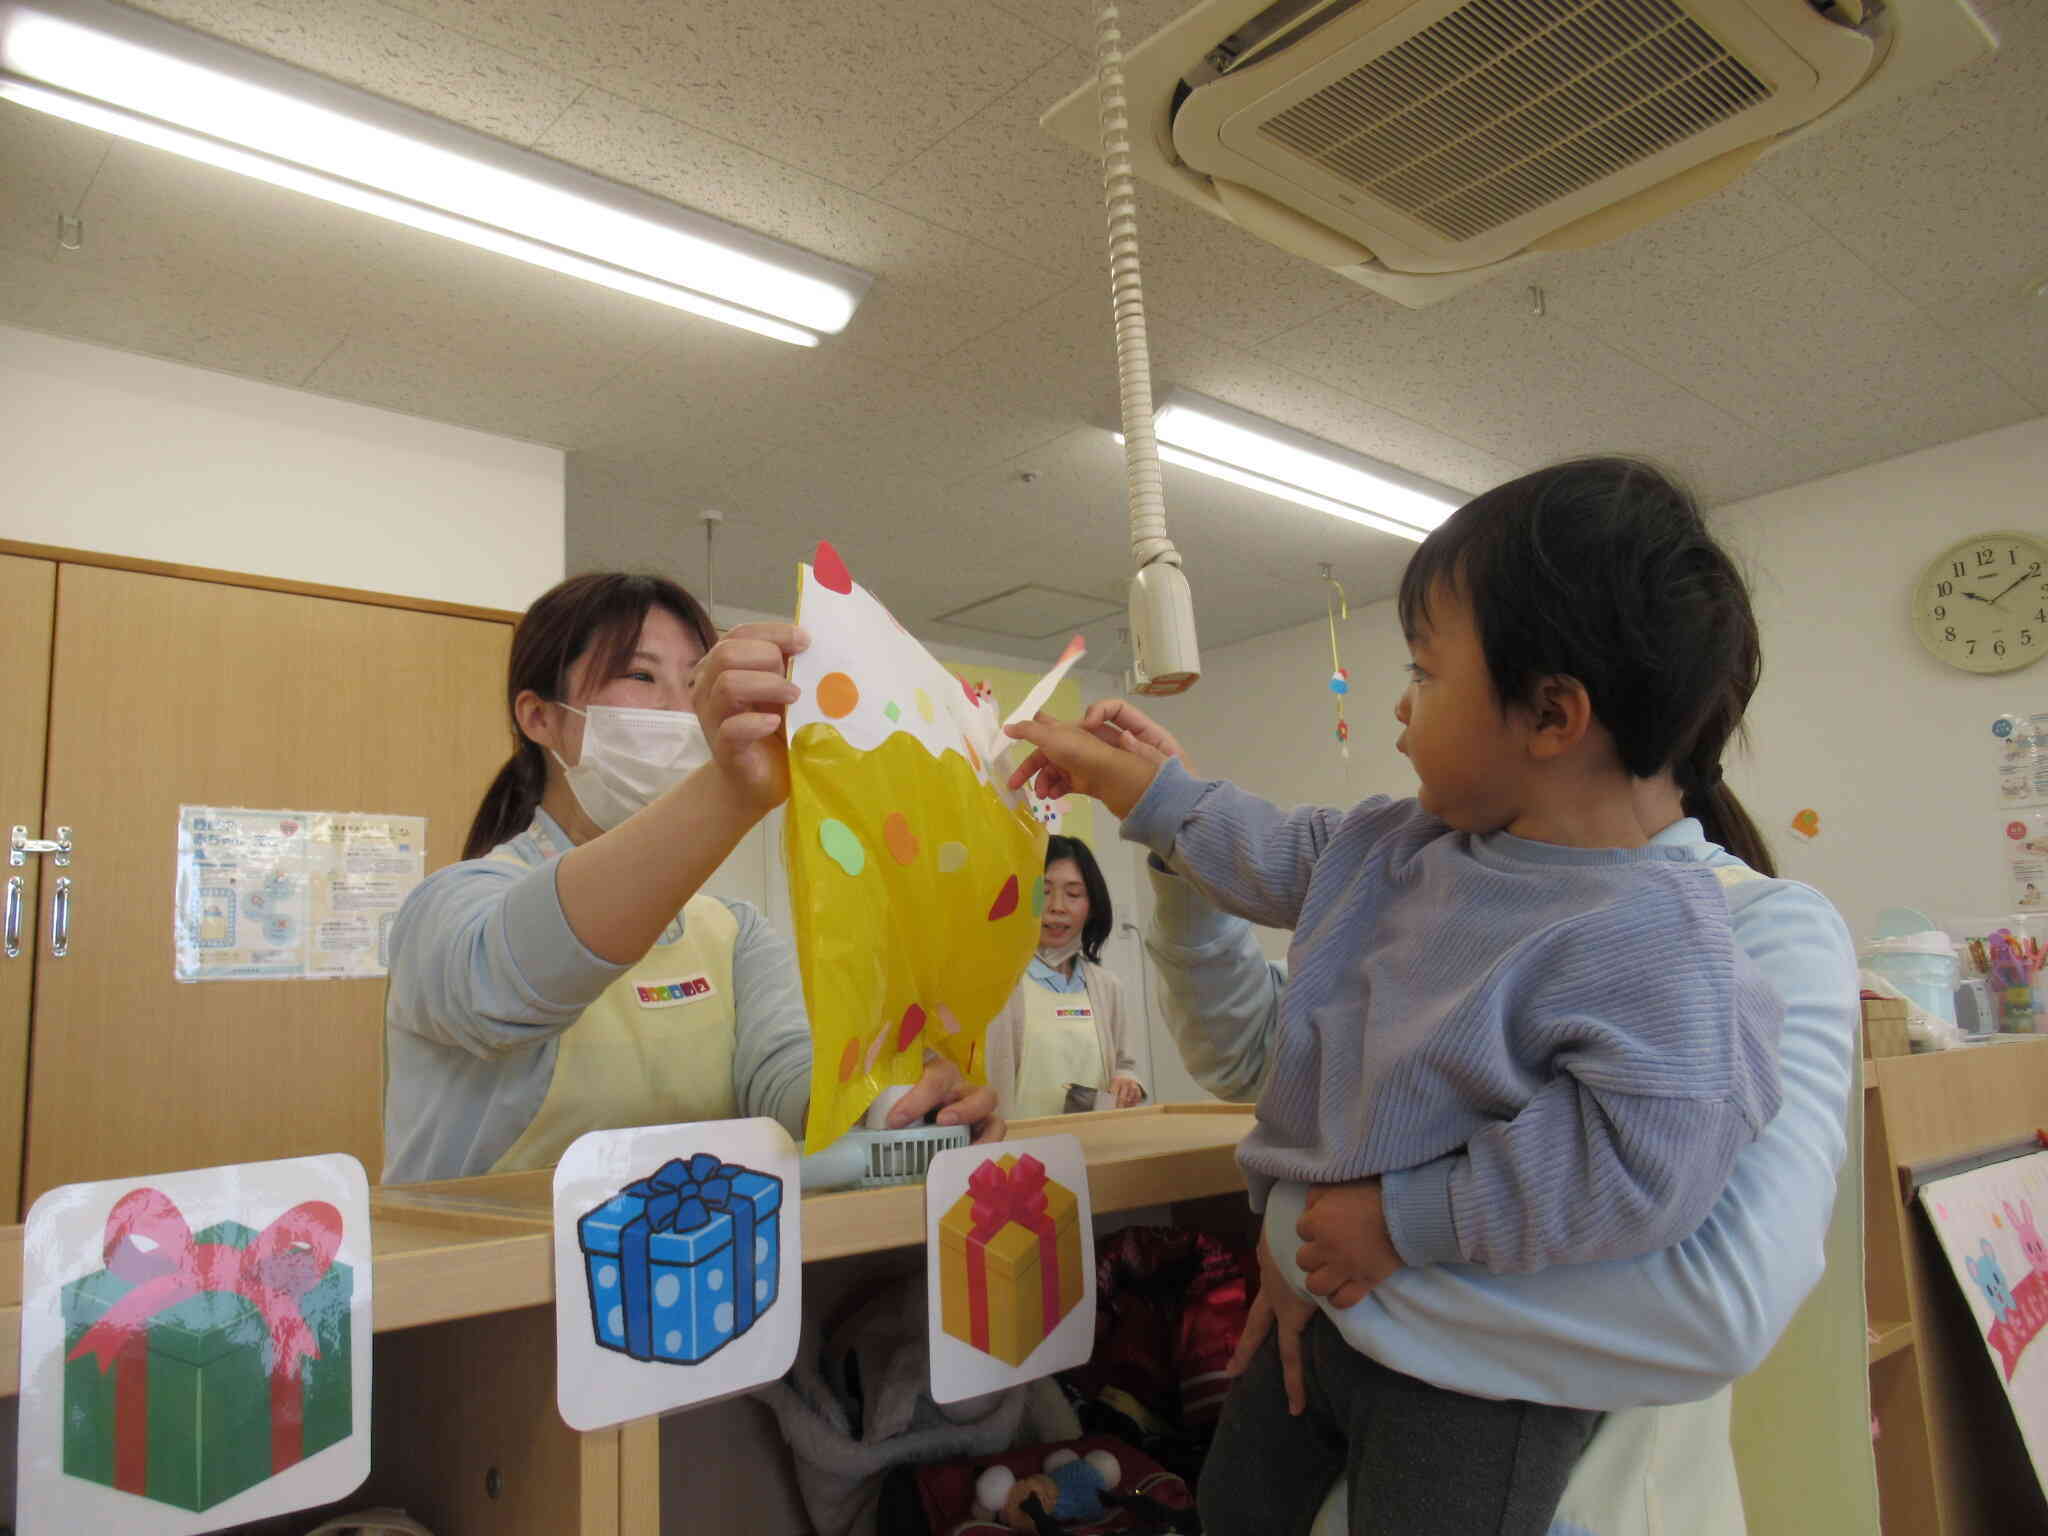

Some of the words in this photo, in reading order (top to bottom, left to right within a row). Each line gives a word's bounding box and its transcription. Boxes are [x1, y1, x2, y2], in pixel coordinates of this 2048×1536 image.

[1976, 549, 1995, 566] 12
[2008, 550, 2016, 565] 1
[1952, 561, 1966, 577] 11
[2028, 562, 2041, 578] 2
[1937, 580, 1953, 597] 10
[1934, 606, 1946, 620] 9
[2034, 608, 2047, 624] 4
[1945, 626, 1956, 642] 8
[2020, 629, 2031, 645] 5
[1966, 639, 1976, 655] 7
[1993, 640, 2006, 656] 6
